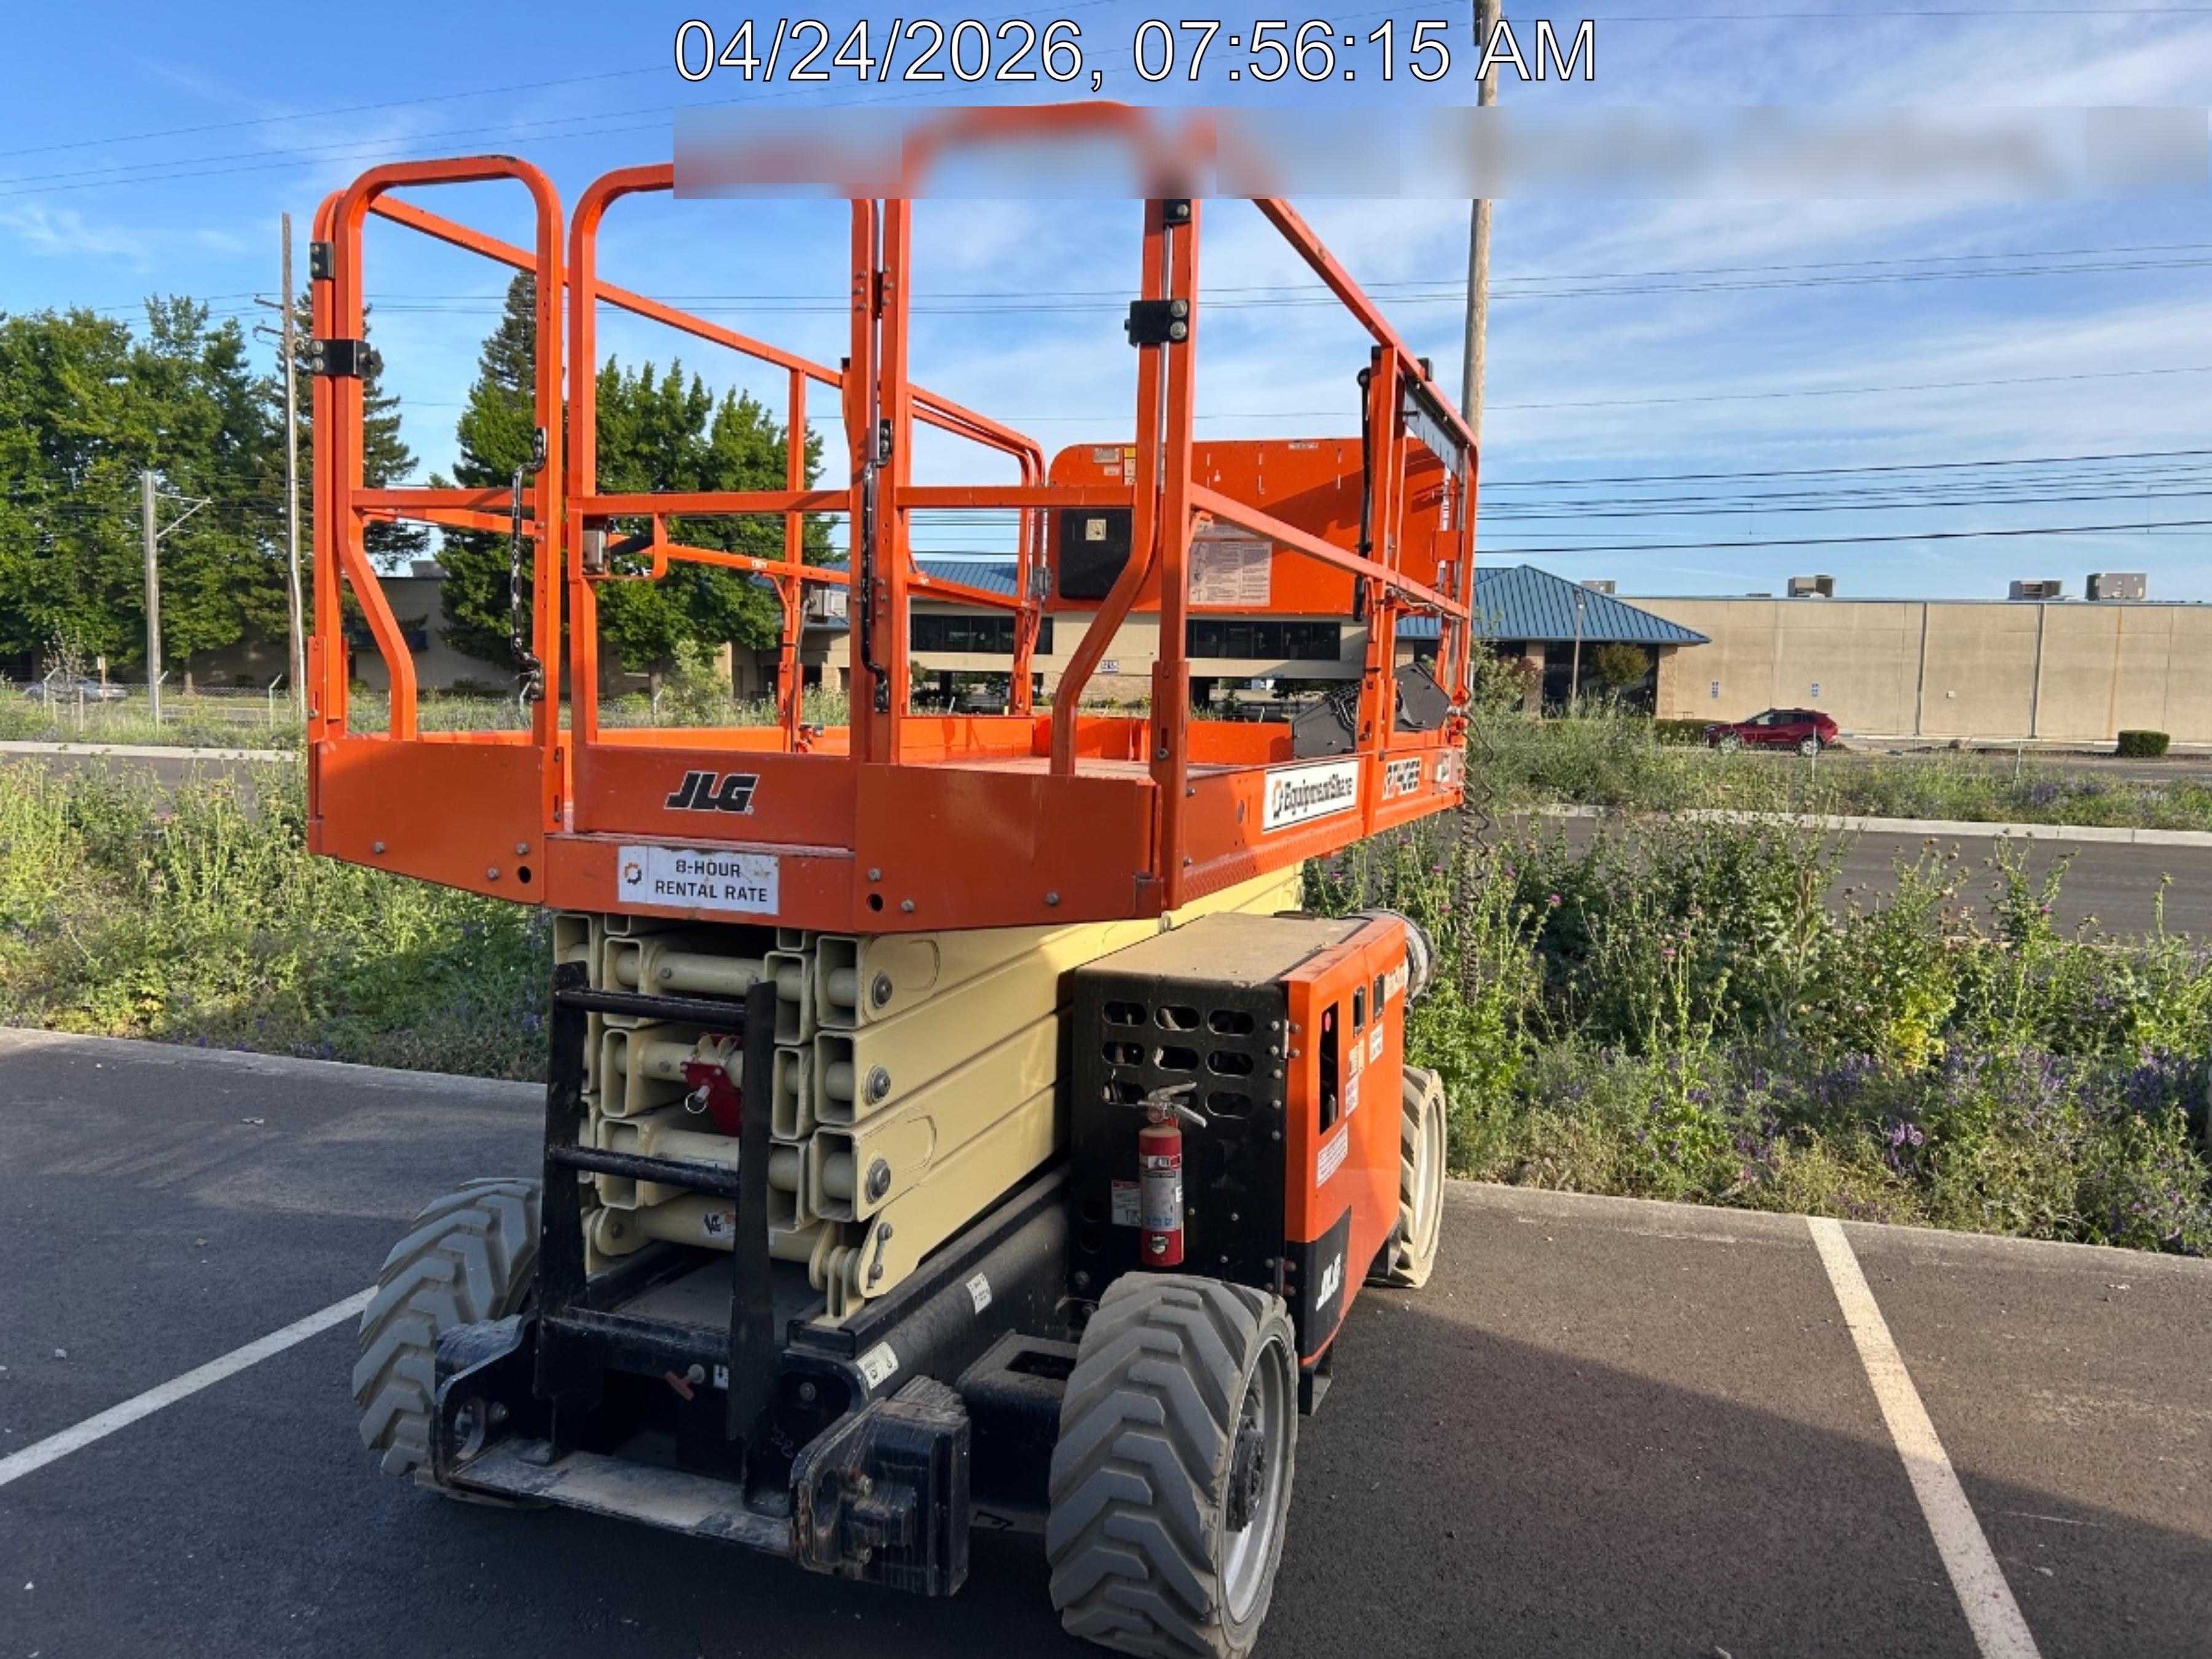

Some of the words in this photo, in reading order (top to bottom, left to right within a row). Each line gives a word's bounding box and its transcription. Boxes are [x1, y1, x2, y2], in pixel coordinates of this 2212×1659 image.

[664, 770, 760, 814] JLG
[676, 860, 741, 877] 8-HOUR
[655, 879, 718, 899] RENTAL
[724, 885, 768, 902] RATE
